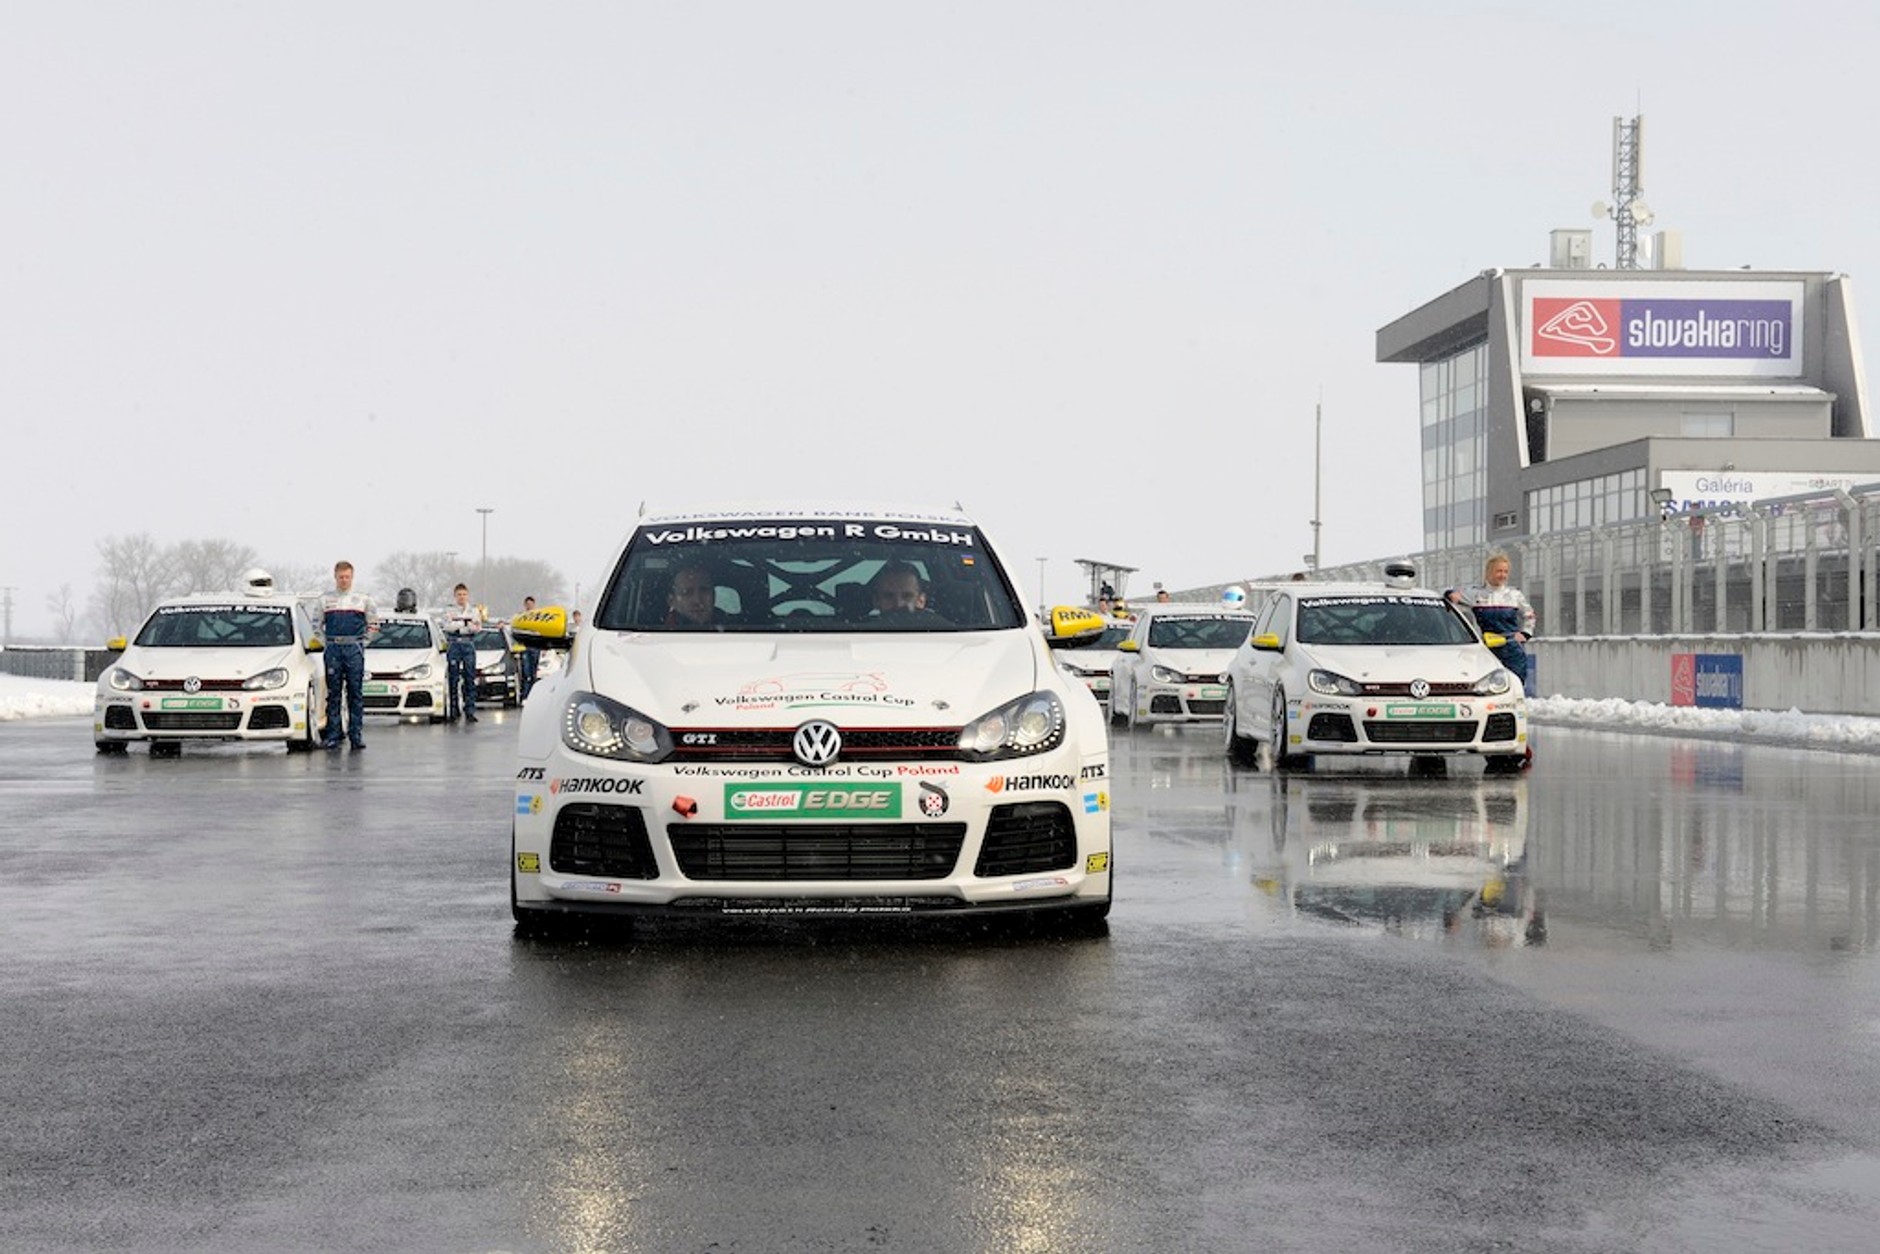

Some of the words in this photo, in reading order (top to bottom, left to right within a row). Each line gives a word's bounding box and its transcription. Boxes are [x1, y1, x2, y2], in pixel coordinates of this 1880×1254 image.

[1695, 477, 1753, 493] Galéria
[1667, 499, 1783, 517] SAMSG
[646, 525, 835, 545] Volkswagen
[845, 524, 865, 537] R
[874, 524, 974, 546] GmbH
[1301, 597, 1388, 608] Volkswagen
[1388, 596, 1398, 604] R
[1401, 597, 1445, 608] GmbH
[160, 606, 232, 615] Volkswagen
[714, 693, 814, 706] Volkswagen
[820, 691, 877, 702] Castrol
[882, 694, 915, 706] Cup
[736, 702, 775, 711] Poland
[682, 733, 717, 744] GTI
[673, 765, 782, 779] Volkswagen
[788, 765, 853, 777] Castrol
[857, 765, 893, 779] Cup
[897, 765, 960, 776] Poland
[747, 793, 797, 808] Castrol
[803, 790, 892, 809] EDGE
